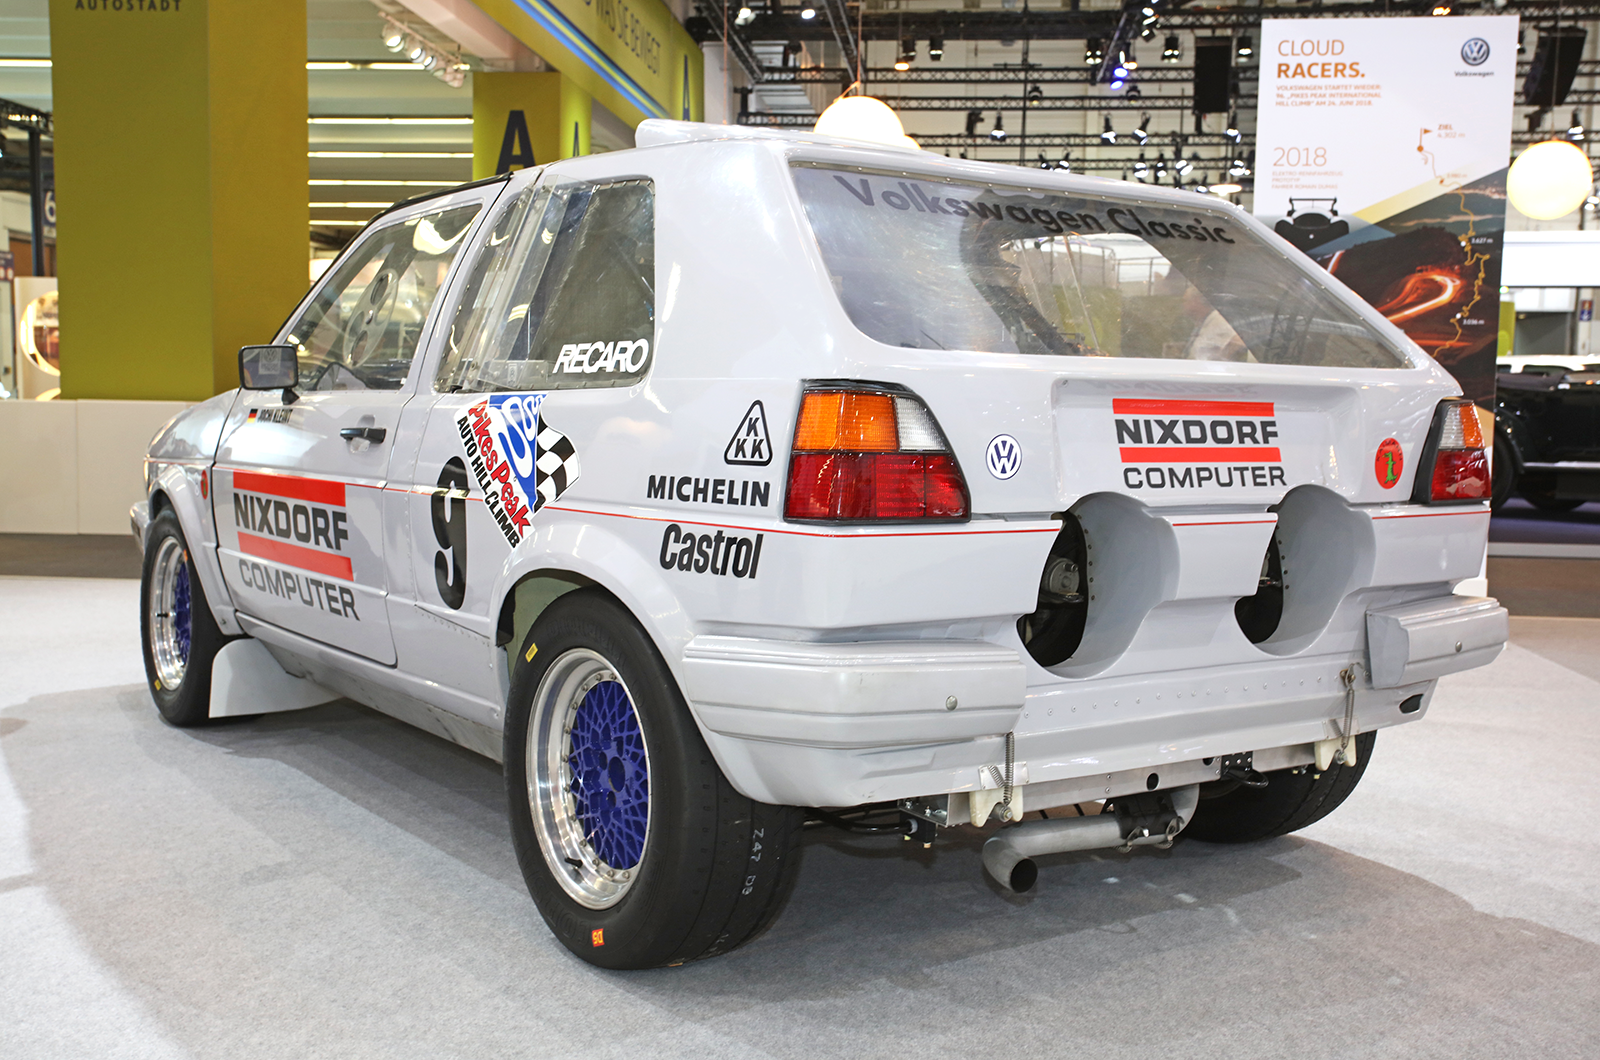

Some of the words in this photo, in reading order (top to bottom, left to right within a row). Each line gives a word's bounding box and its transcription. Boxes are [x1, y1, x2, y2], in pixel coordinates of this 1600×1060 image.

[75, 0, 181, 11] AUTOSTADT
[1277, 62, 1365, 78] RACERS.
[1278, 39, 1345, 56] CLOUD
[495, 110, 536, 176] A
[1273, 146, 1327, 167] 2018
[833, 175, 1106, 233] Volkswagen
[1106, 208, 1236, 244] Classic
[552, 338, 649, 374] RECARO
[1114, 419, 1279, 444] NIXDORF
[456, 415, 478, 458] AUTO
[471, 456, 492, 495] HILL
[484, 491, 521, 549] CLIMB
[468, 400, 498, 471] Pikes
[490, 460, 531, 539] Peak
[646, 474, 770, 507] MICHELIN
[1123, 466, 1287, 488] COMPUTER
[233, 492, 349, 551] NIXDORF
[431, 456, 470, 610] 9
[659, 523, 764, 579] Castrol
[239, 559, 361, 622] COMPUTER
